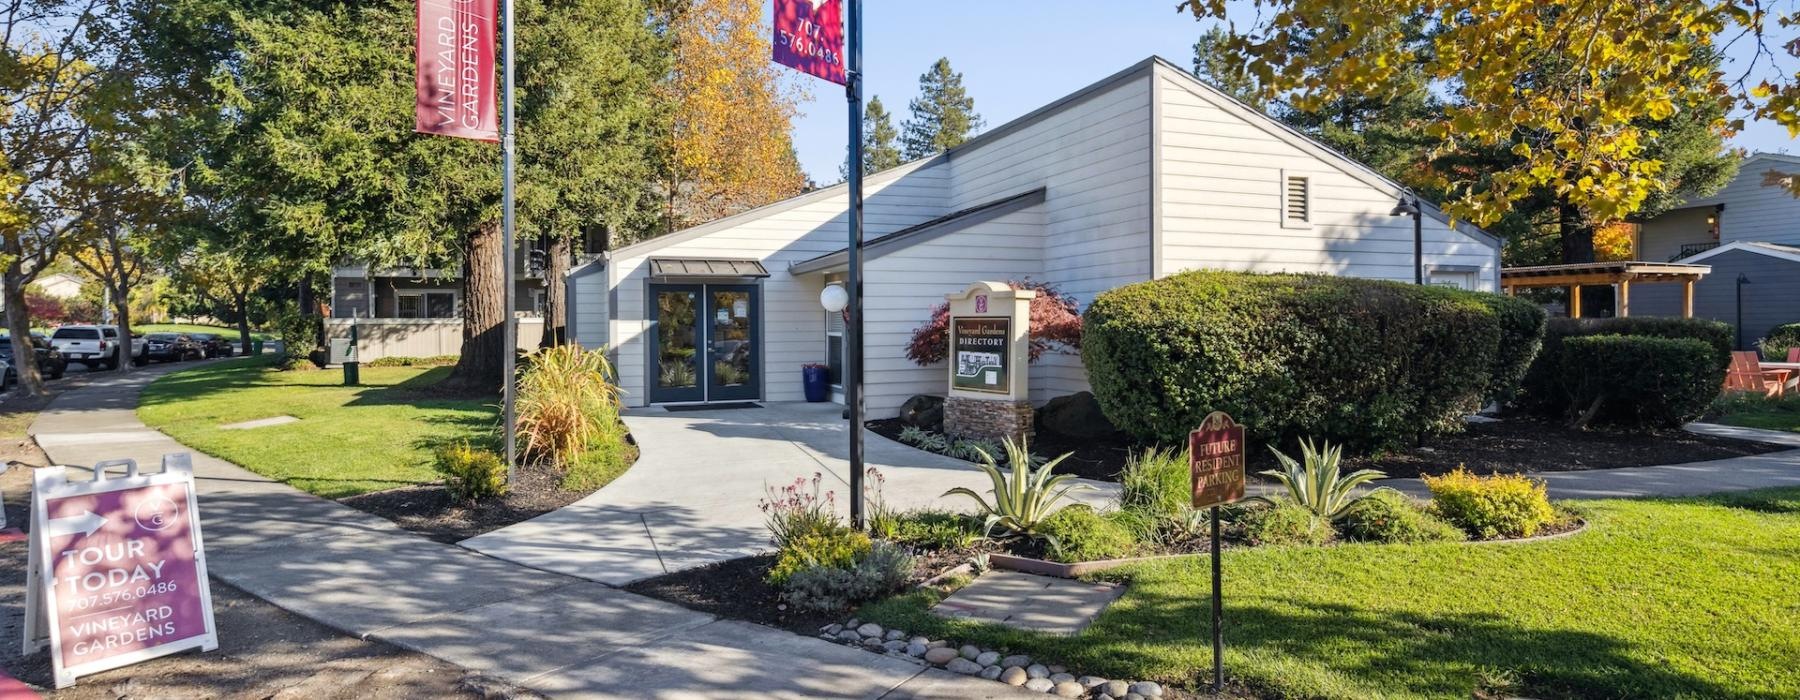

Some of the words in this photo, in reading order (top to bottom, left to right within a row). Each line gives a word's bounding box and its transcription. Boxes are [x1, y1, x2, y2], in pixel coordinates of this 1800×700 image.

[780, 30, 840, 66] 576.0486
[438, 16, 456, 126] VINEYARD
[462, 22, 479, 129] GARDENS
[958, 324, 981, 336] Vineyard
[982, 323, 1005, 335] Gardens
[959, 338, 1003, 346] DIRECTORY
[1195, 454, 1240, 473] RESIDENT
[1200, 440, 1236, 457] FUTURE
[1197, 469, 1238, 489] PARKING
[62, 540, 145, 570] TOUR
[65, 560, 166, 595] TODAY
[68, 580, 177, 612] 707.576.0486
[69, 605, 173, 638] VINEYARD
[73, 621, 175, 656] GARDENS
